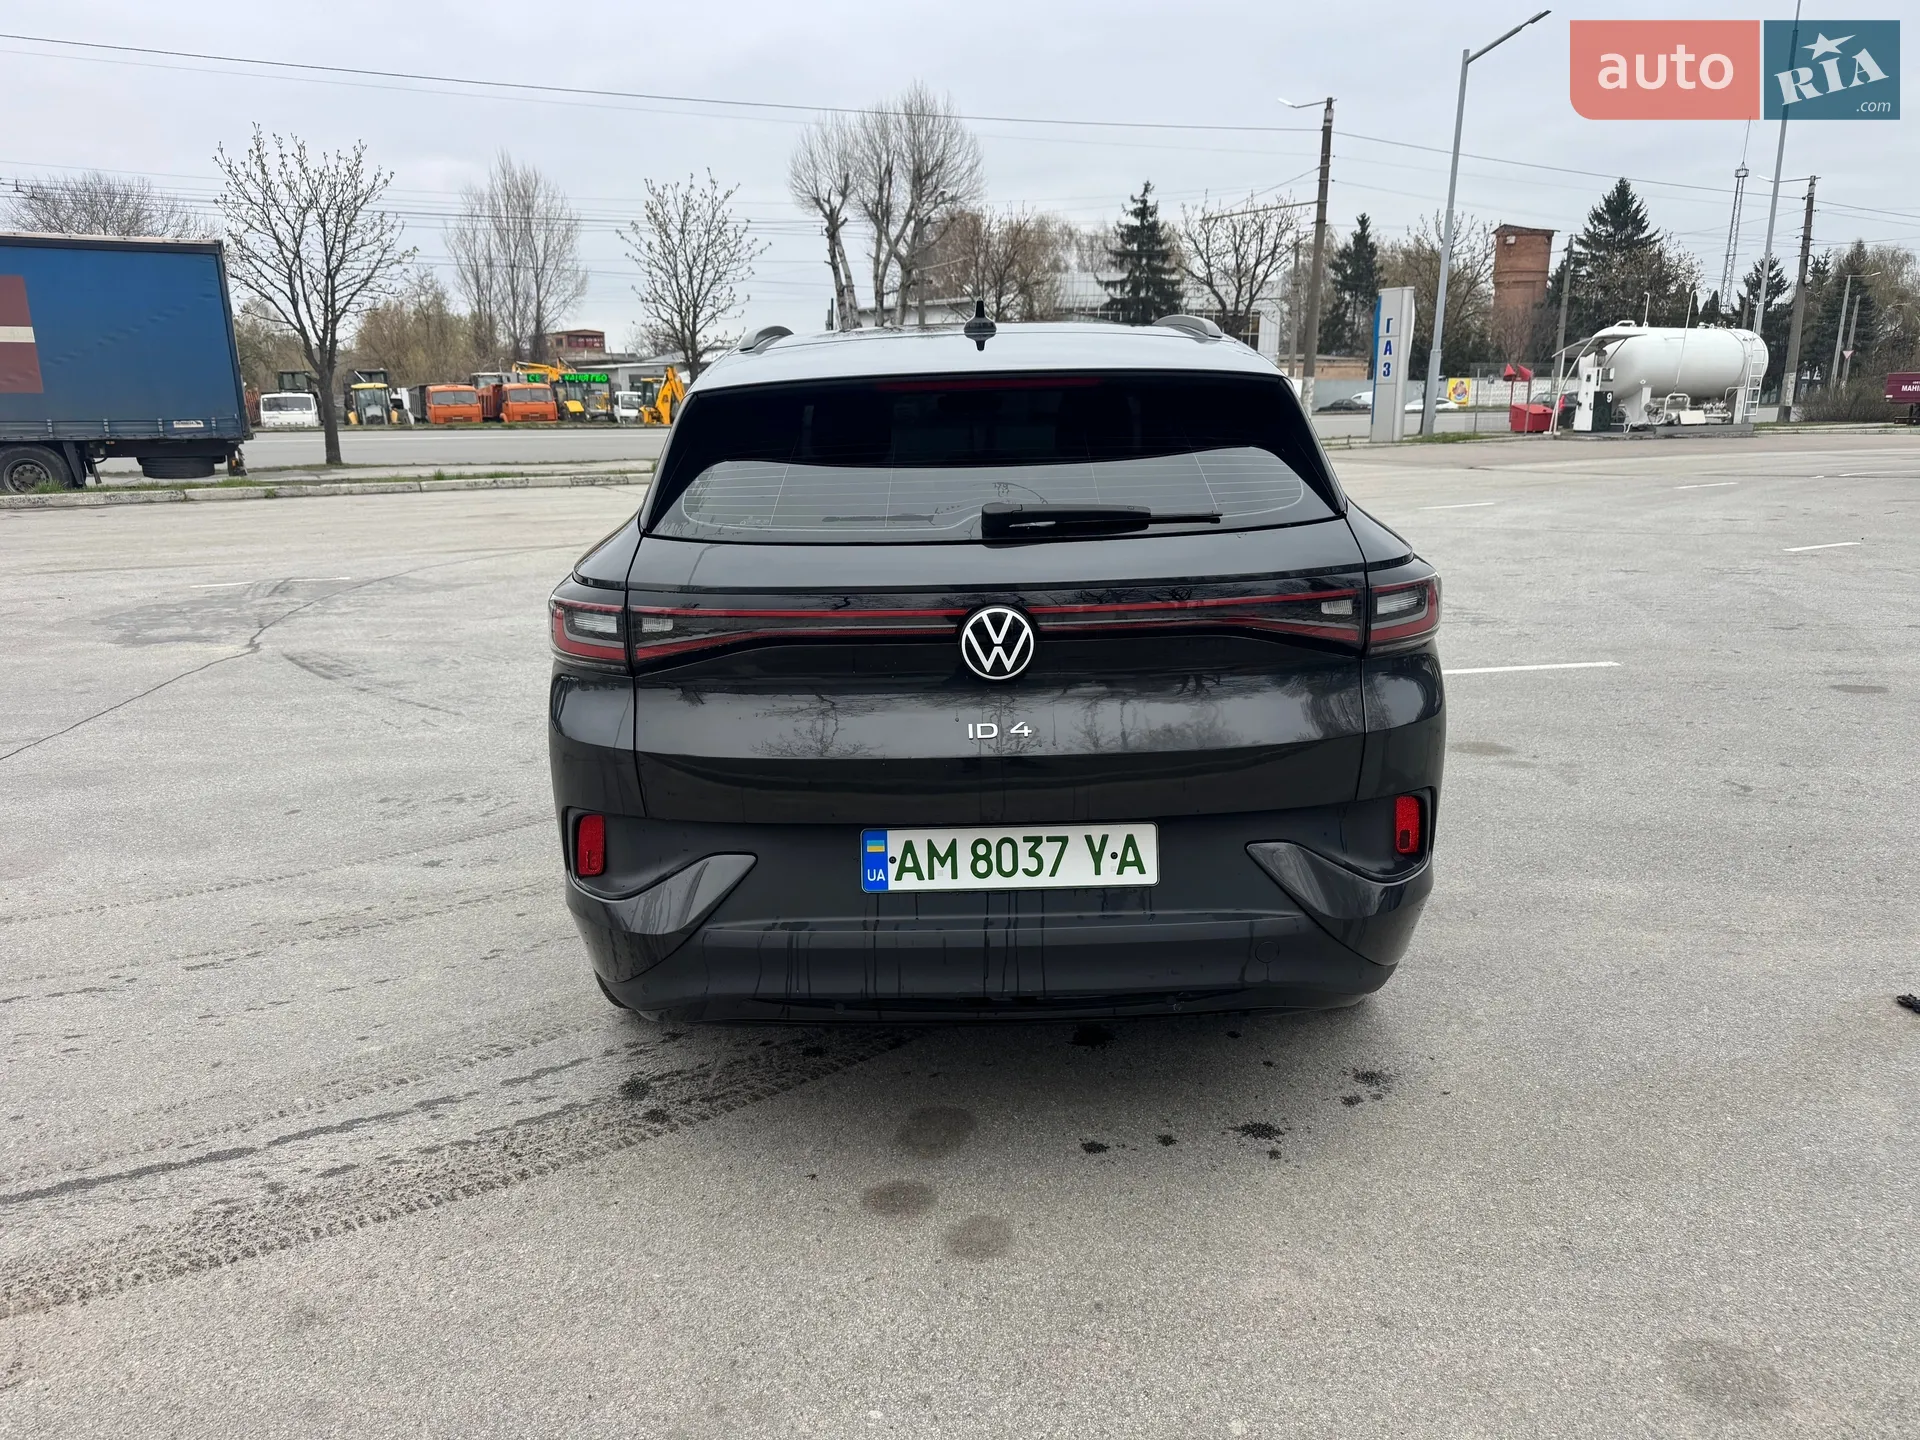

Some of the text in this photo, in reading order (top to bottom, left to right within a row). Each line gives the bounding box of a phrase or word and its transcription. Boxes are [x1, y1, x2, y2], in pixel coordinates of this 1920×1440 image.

[1383, 318, 1393, 377] ГАЗ
[1606, 392, 1613, 403] 9
[1010, 721, 1033, 737] 4
[894, 833, 1147, 881] AM 8037 YA
[867, 869, 886, 882] UA
